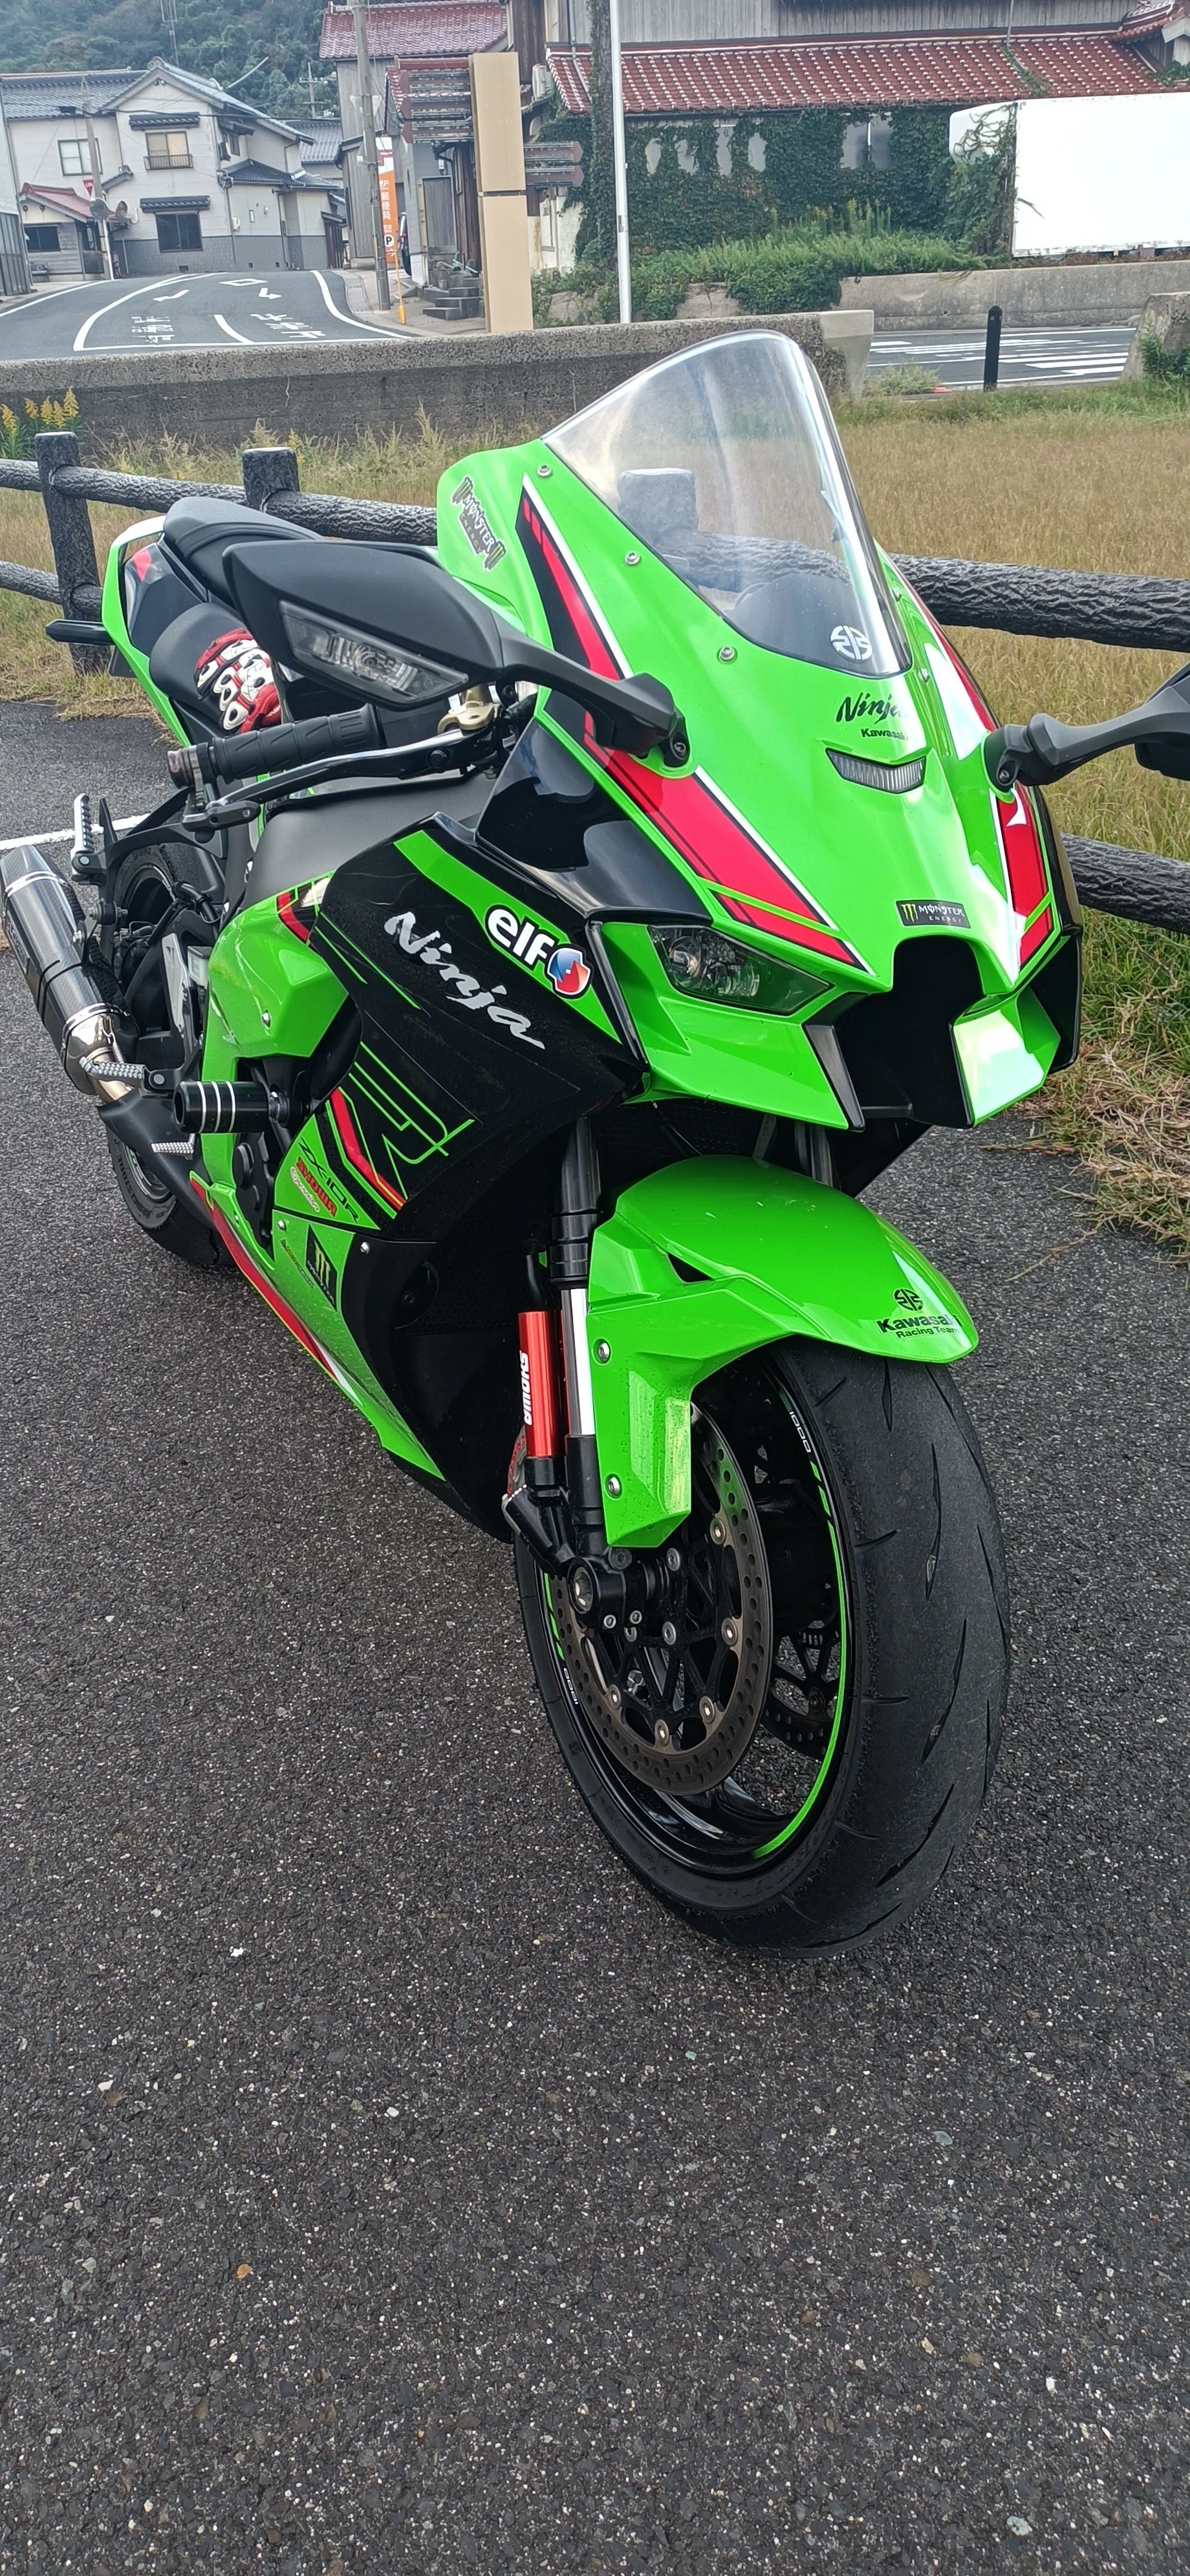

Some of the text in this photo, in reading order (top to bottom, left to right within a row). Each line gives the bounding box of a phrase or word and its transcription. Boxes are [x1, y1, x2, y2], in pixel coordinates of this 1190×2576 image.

[460, 513, 482, 553] ENERGY
[836, 692, 902, 725] Ninja
[488, 908, 555, 965] elf
[928, 915, 962, 923] ENERGY
[384, 911, 545, 1050] Ninja
[298, 1136, 359, 1224] ZX-10R
[876, 1313, 963, 1333] Kawasaki
[895, 1327, 935, 1338] Racing
[519, 1349, 532, 1426] SHOWA
[789, 1411, 812, 1453] 1000
